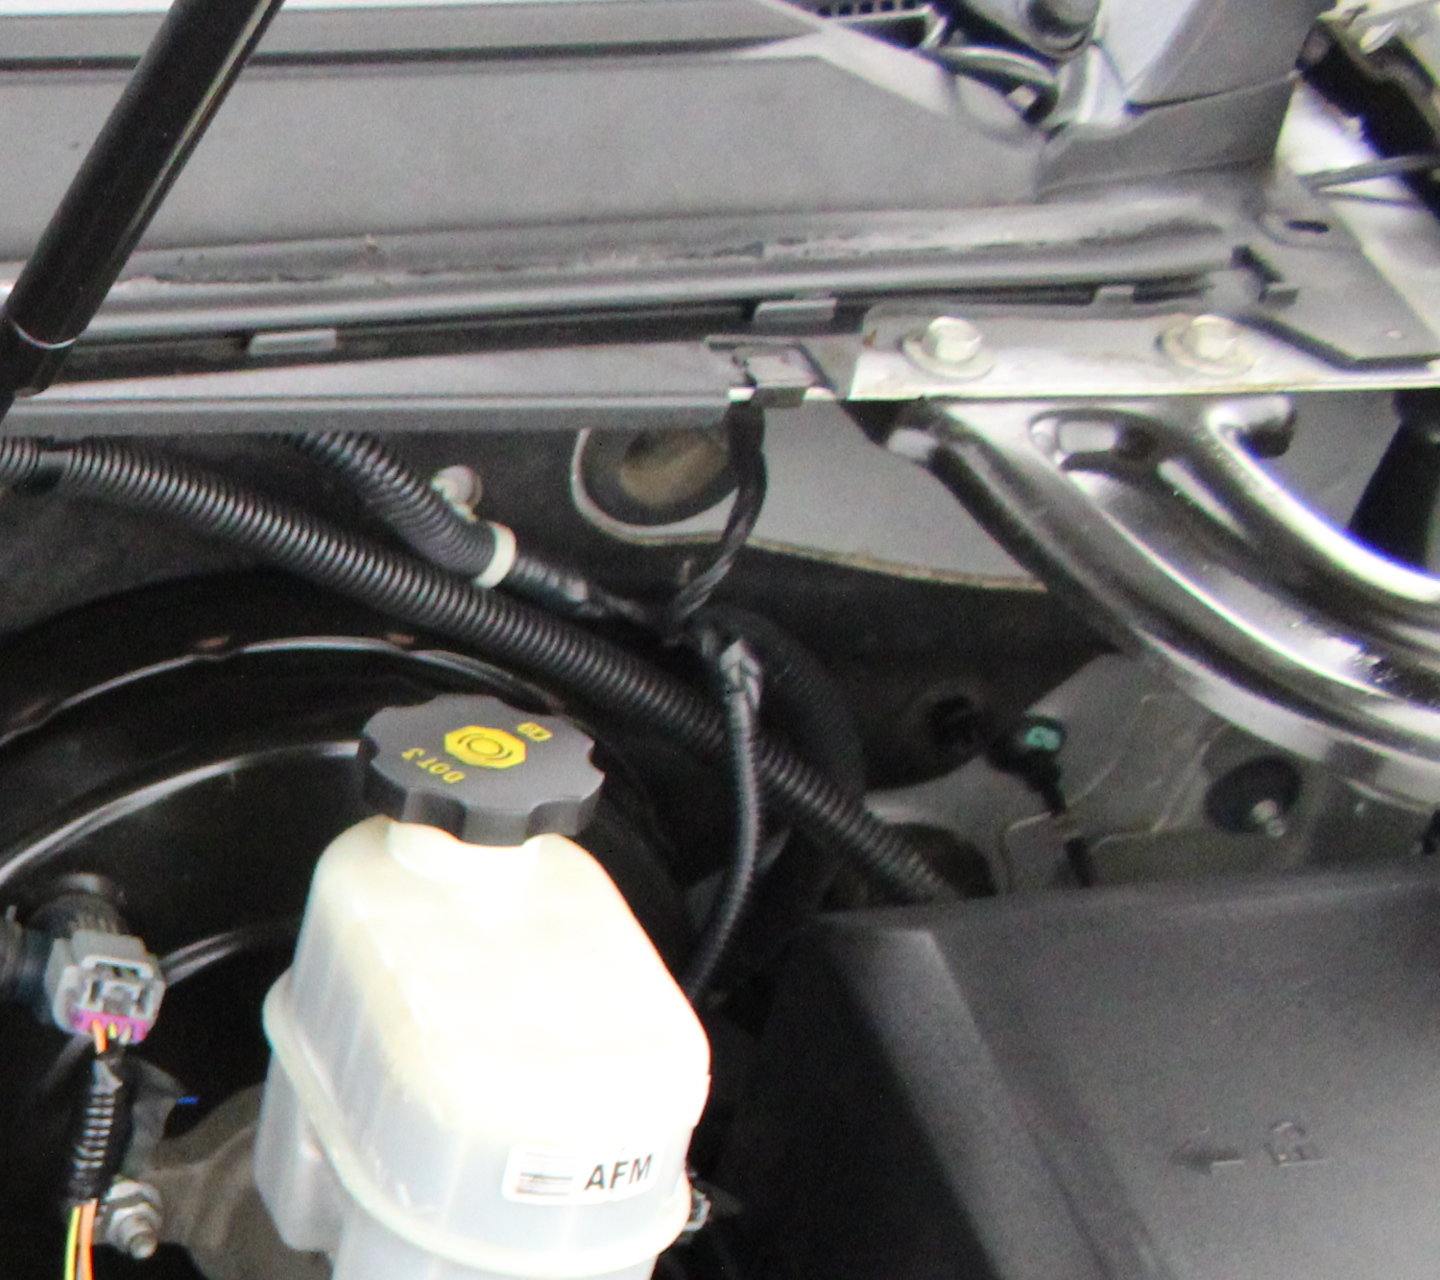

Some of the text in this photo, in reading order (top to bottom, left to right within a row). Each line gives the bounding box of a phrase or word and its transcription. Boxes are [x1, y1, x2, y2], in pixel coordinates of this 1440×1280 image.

[401, 747, 466, 783] DOT 3
[584, 1153, 653, 1191] AFM
